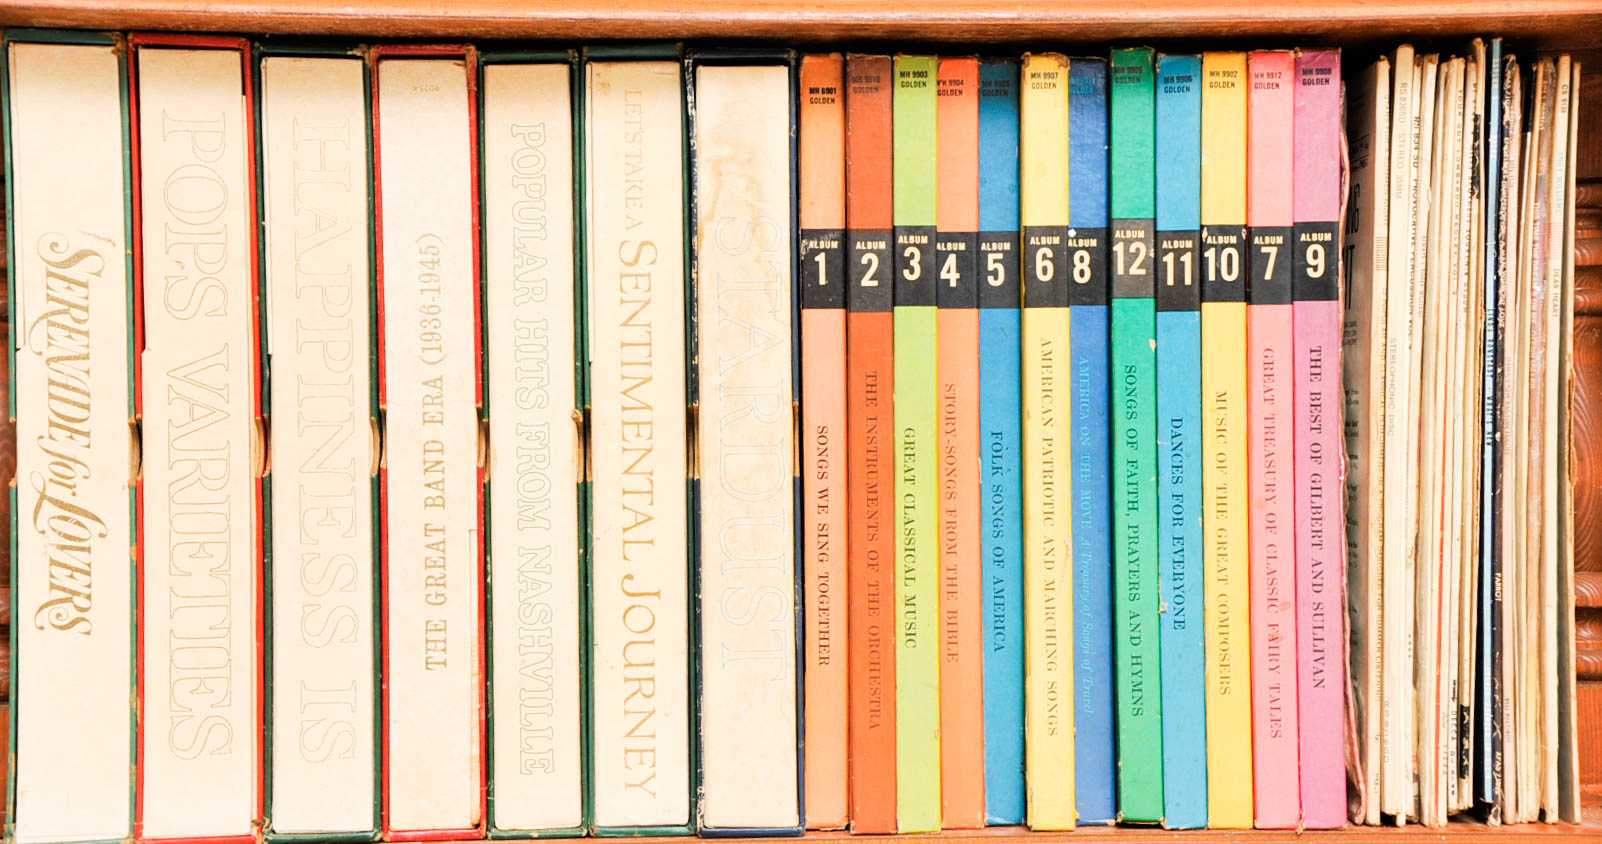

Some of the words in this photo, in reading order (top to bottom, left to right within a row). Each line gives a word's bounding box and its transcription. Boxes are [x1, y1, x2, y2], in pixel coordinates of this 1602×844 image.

[854, 86, 879, 94] GOLDEN
[1115, 76, 1141, 84] GOLDEN
[1222, 70, 1238, 78] 9902
[1303, 78, 1329, 86] GOLDEN
[1400, 83, 1407, 94] RS
[1561, 85, 1568, 96] CS
[624, 90, 644, 145] LET'S
[1396, 133, 1406, 169] STEREO
[624, 151, 644, 211] TAKE
[163, 111, 229, 321] POPS
[511, 123, 549, 306] POPULAR
[625, 214, 644, 232] A
[1115, 229, 1145, 238] ALBUM
[809, 240, 838, 248] ALBUM
[856, 241, 886, 250] ALBUM
[898, 235, 928, 244] ALBUM
[937, 242, 966, 250] ALBUM
[981, 242, 1010, 250] ALBUM
[1030, 236, 1060, 245] ALBUM
[1068, 239, 1098, 248] ALBUM
[1162, 240, 1193, 249] ALBUM
[1206, 235, 1236, 244] ALBUM
[1254, 236, 1283, 244] ALBUM
[1300, 233, 1331, 242] ALBUM
[814, 252, 826, 285] 1
[860, 253, 879, 286] 2
[903, 247, 921, 280] 3
[940, 254, 960, 287] 4
[987, 253, 1005, 286] 5
[1035, 248, 1054, 282] 6
[1073, 250, 1091, 284] 8
[1113, 242, 1146, 275] 12
[1163, 252, 1192, 286] 11
[1204, 247, 1239, 282] 10
[1261, 247, 1278, 280] 7
[1306, 243, 1325, 279] 9
[417, 234, 446, 366] (1936-1945)
[30, 232, 105, 449] SERENADE
[293, 118, 360, 650] HAPPINESS
[514, 320, 550, 410] HITS
[1041, 337, 1053, 427] AMERICAN
[1263, 348, 1275, 404] GREAT
[1310, 346, 1322, 382] THE
[1389, 338, 1397, 409] STEREOPHONIC
[422, 376, 444, 427] ERA
[620, 240, 657, 562] SENTIMENTAL
[865, 371, 878, 409] THE
[1079, 356, 1090, 420] AMERICA
[1125, 364, 1137, 420] SONGS
[1216, 391, 1228, 443] MUSIC
[1310, 391, 1323, 432] BEST
[716, 216, 788, 683] STARDUST
[816, 425, 829, 480] SONGS
[904, 427, 916, 485] GREAT
[945, 383, 958, 500] STORY-SONGS
[992, 431, 1004, 476] FOLK
[1080, 427, 1091, 446] ON
[1126, 428, 1138, 450] OF
[1171, 417, 1184, 484] DANCES
[1310, 442, 1322, 465] OF
[37, 435, 90, 499] for
[423, 440, 445, 512] BAND
[516, 422, 551, 532] FROM
[866, 416, 879, 541] INSTRUMENTS
[1080, 453, 1092, 482] THE
[1216, 451, 1228, 474] OF
[1264, 413, 1277, 503] TREASURY
[817, 487, 829, 515] WE
[1042, 437, 1055, 526] PATRIOTIC
[1125, 459, 1139, 516] FAITH,
[1216, 482, 1228, 520] THE
[992, 484, 1004, 538] SONGS
[1080, 490, 1093, 528] MOVE
[1171, 492, 1184, 526] FOR
[1265, 512, 1277, 535] OF
[1310, 472, 1324, 550] GILBERT
[168, 344, 233, 762] VARIETIES
[818, 522, 829, 562] SING
[904, 493, 916, 586] CLASSICAL
[946, 510, 958, 556] FROM
[1043, 535, 1056, 570] AND
[1082, 537, 1093, 546] A
[31, 492, 108, 637] LOVERS
[422, 525, 446, 607] GREAT
[867, 550, 879, 572] OF
[992, 546, 1004, 568] OF
[1079, 552, 1094, 600] Treasury
[1128, 524, 1140, 601] PRAYERS
[1217, 527, 1229, 585] GREAT
[1311, 558, 1324, 593] AND
[868, 581, 880, 616] THE
[946, 564, 958, 600] THE
[1172, 535, 1186, 630] EVERYONE
[1266, 543, 1279, 613] CLASSIC
[818, 572, 830, 666] TOGETHER
[904, 594, 917, 648] MUSIC
[993, 575, 1005, 652] AMERICA
[1044, 579, 1057, 671] MARCHING
[1082, 605, 1094, 615] of
[1129, 610, 1142, 645] AND
[424, 620, 447, 672] THE
[947, 609, 959, 662] BIBLE
[1080, 622, 1094, 655] Songs
[1218, 593, 1231, 695] COMPOSERS
[1268, 622, 1280, 673] FAIRY
[1312, 601, 1325, 689] SULLIVAN
[518, 546, 555, 776] NASHVILLE
[868, 625, 881, 730] ORCHESTRA
[1083, 659, 1095, 671] of
[621, 574, 662, 801] JOURNEY
[1083, 677, 1095, 713] Travel
[1130, 654, 1144, 717] HYMNS
[300, 680, 360, 764] IS
[1047, 680, 1058, 736] SONGS
[1269, 682, 1282, 738] TALES
